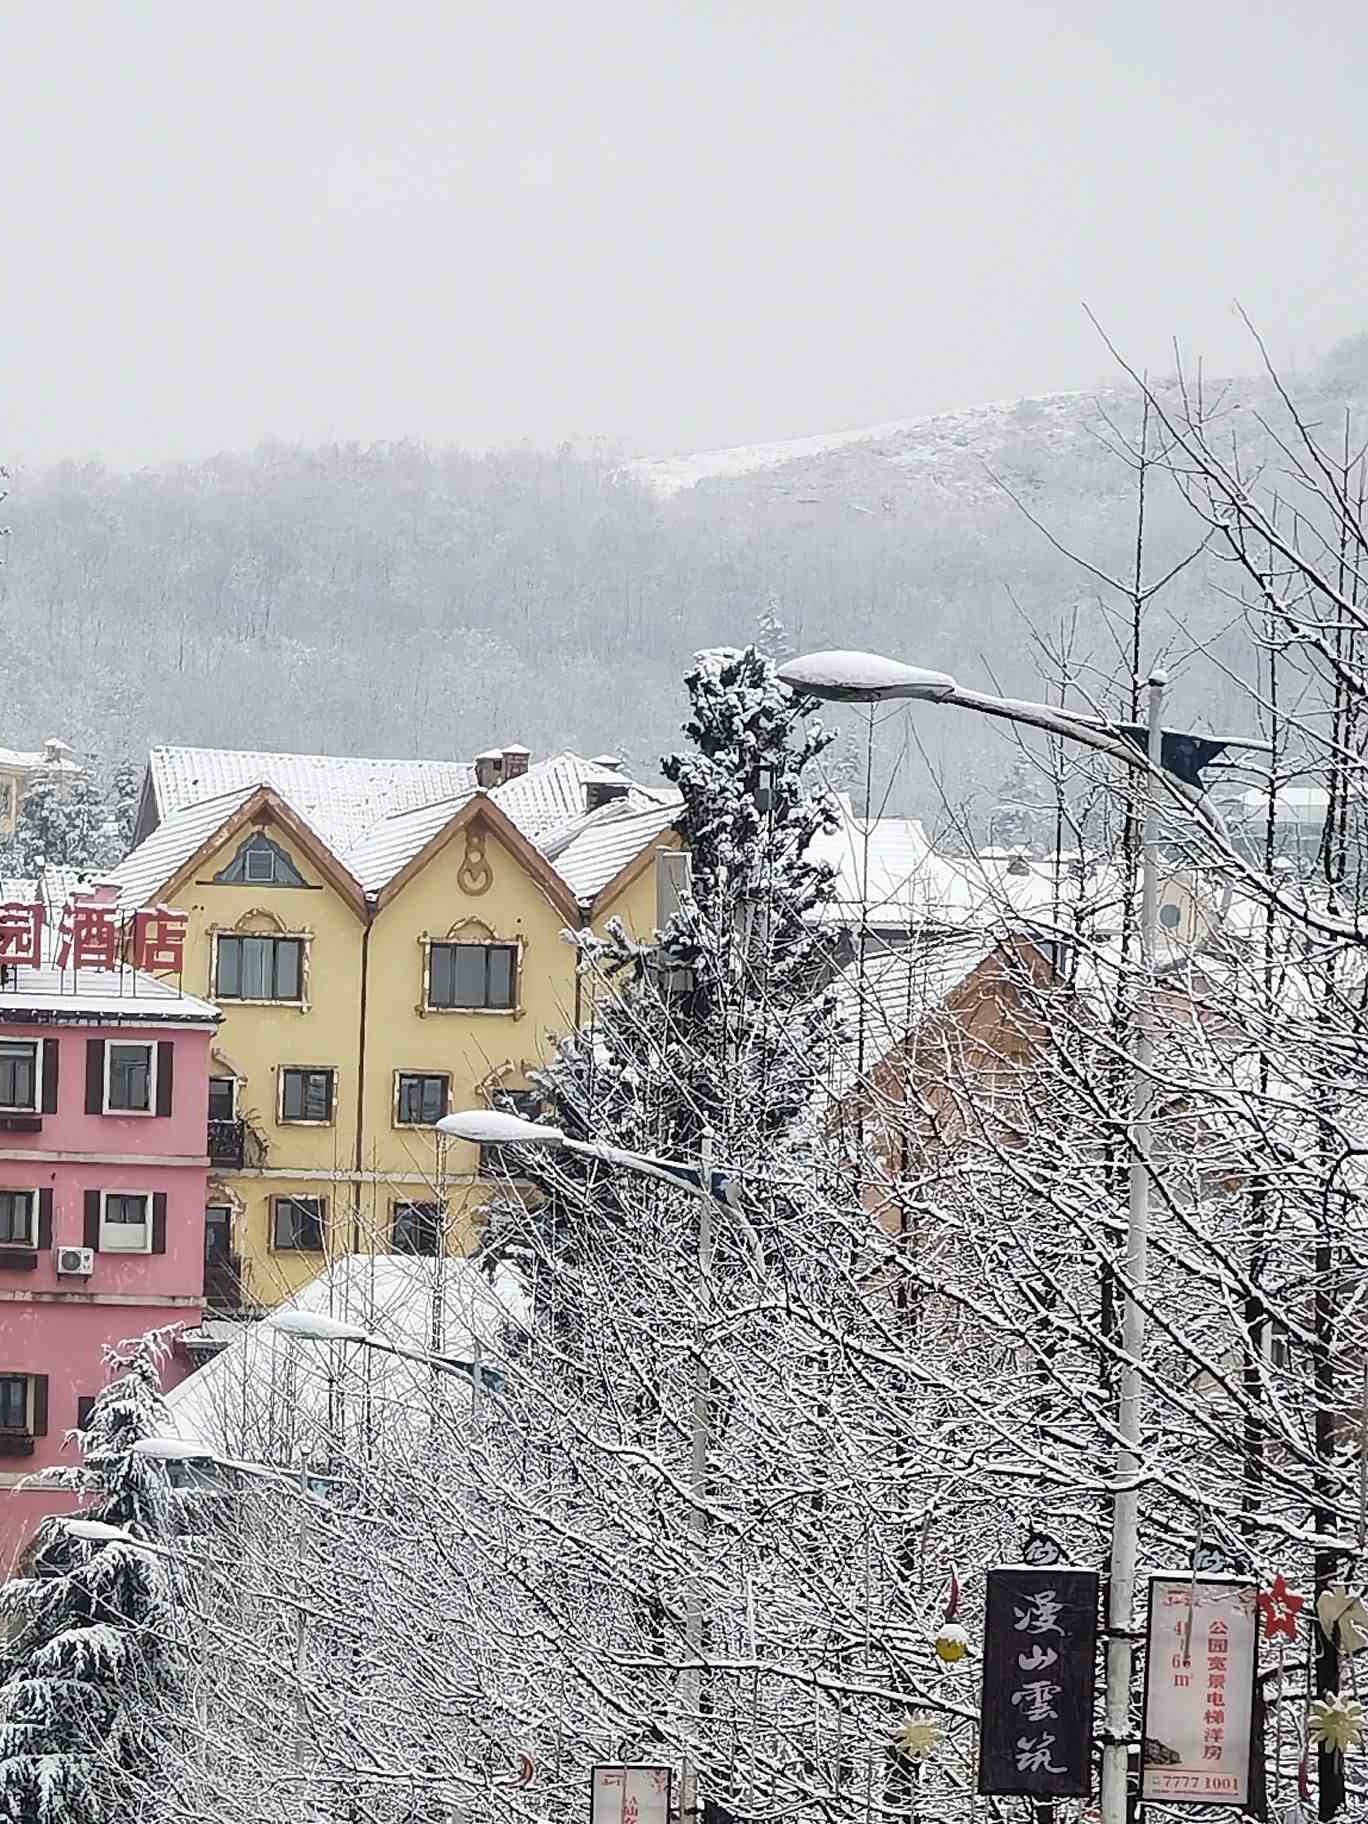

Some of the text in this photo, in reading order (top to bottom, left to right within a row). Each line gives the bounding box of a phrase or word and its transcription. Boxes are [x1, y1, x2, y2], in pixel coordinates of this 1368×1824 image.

[1202, 1620, 1229, 1761] 公园宽景电梯洋房
[1163, 1776, 1239, 1791] 7777 1001
